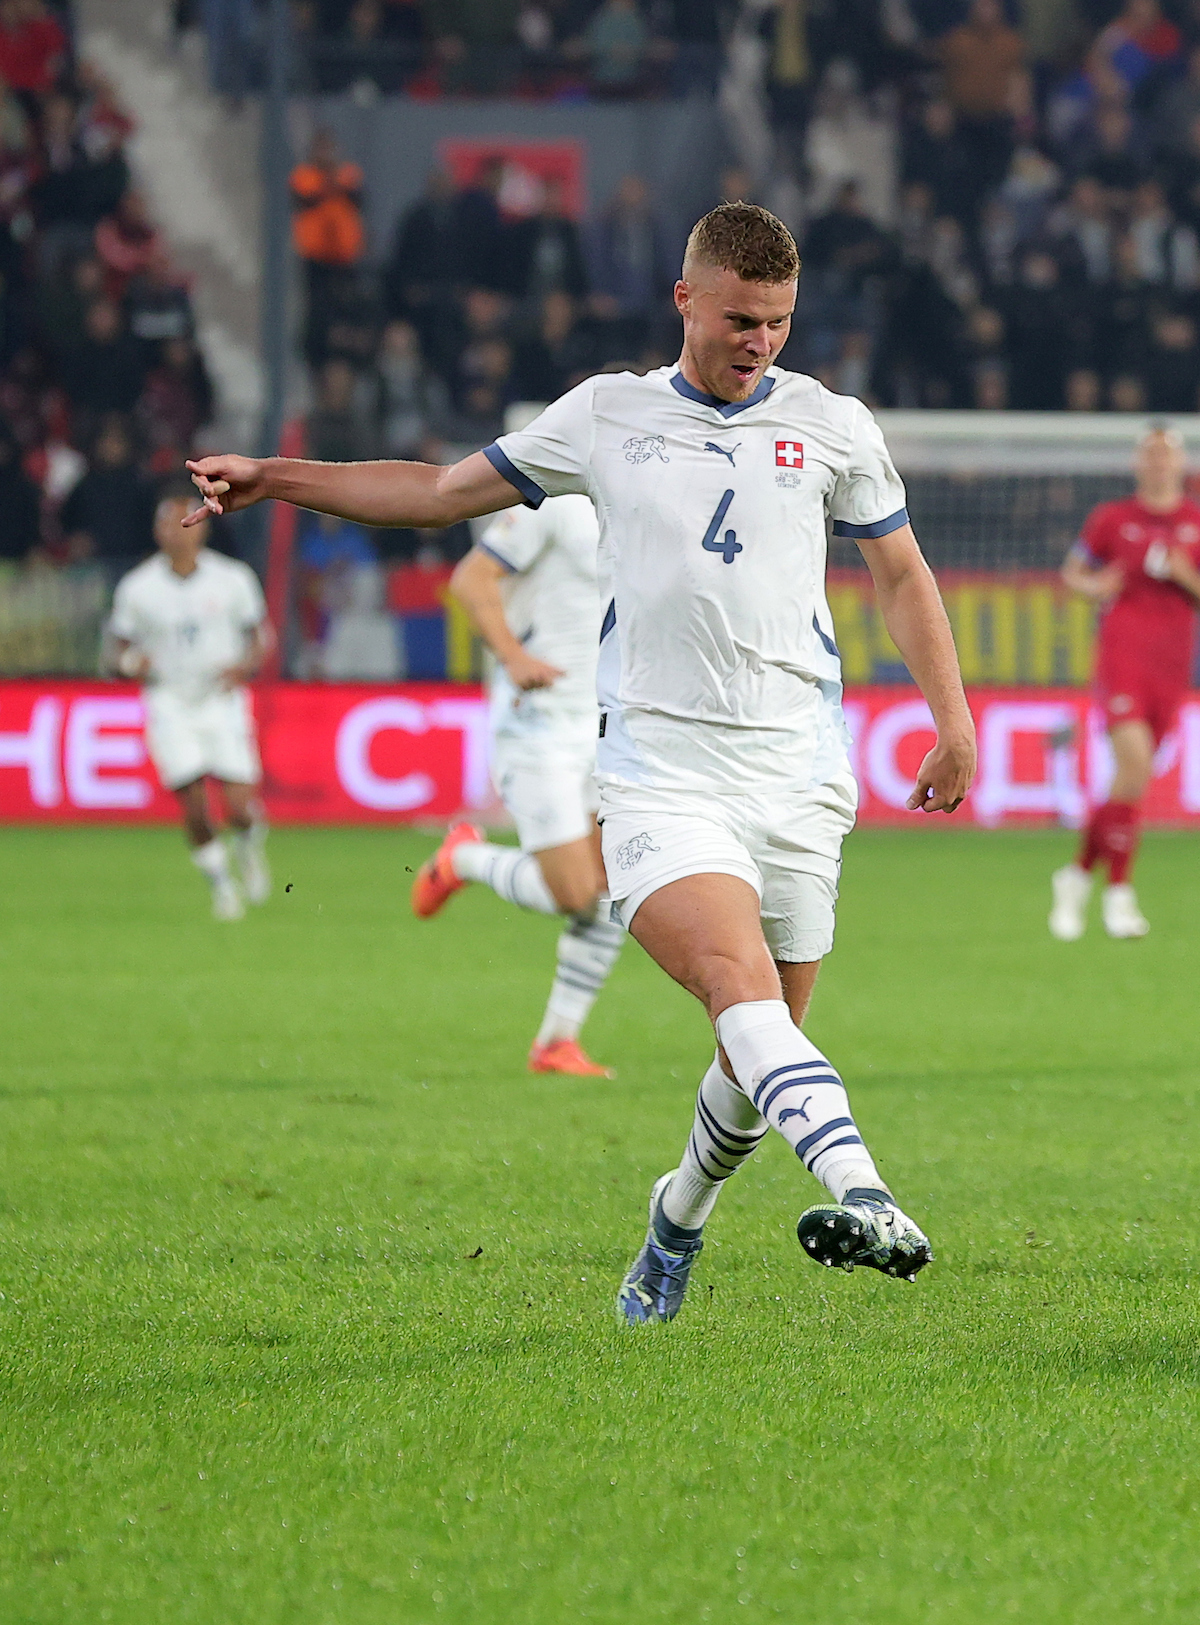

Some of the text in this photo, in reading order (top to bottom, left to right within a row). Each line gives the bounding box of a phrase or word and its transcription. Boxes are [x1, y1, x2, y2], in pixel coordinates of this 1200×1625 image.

[702, 489, 743, 564] 4
[0, 696, 152, 809] НЕ
[335, 696, 500, 811] СТ
